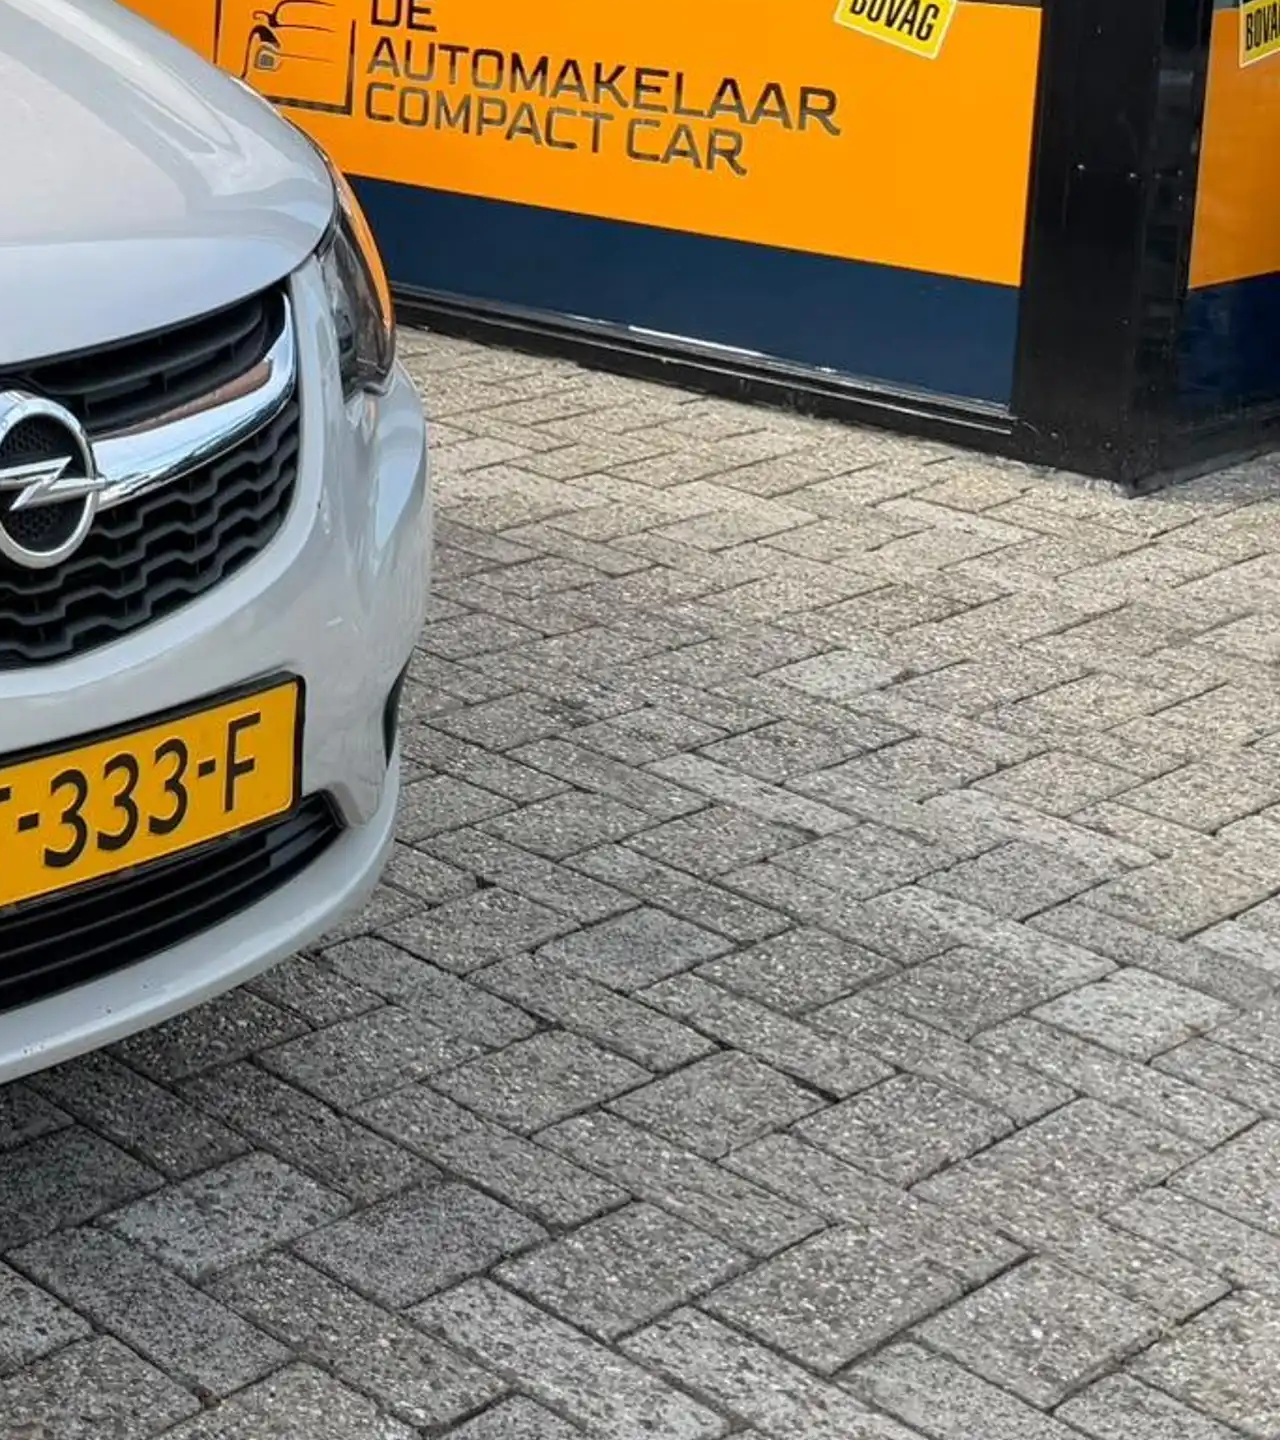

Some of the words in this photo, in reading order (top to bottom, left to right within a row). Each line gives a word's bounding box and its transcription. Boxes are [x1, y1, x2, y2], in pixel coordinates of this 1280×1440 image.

[1245, 1, 1280, 51] BOVA
[365, 81, 615, 154] COMPACT
[625, 116, 748, 176] CAR
[366, 35, 842, 136] AUTOMAKELAAR
